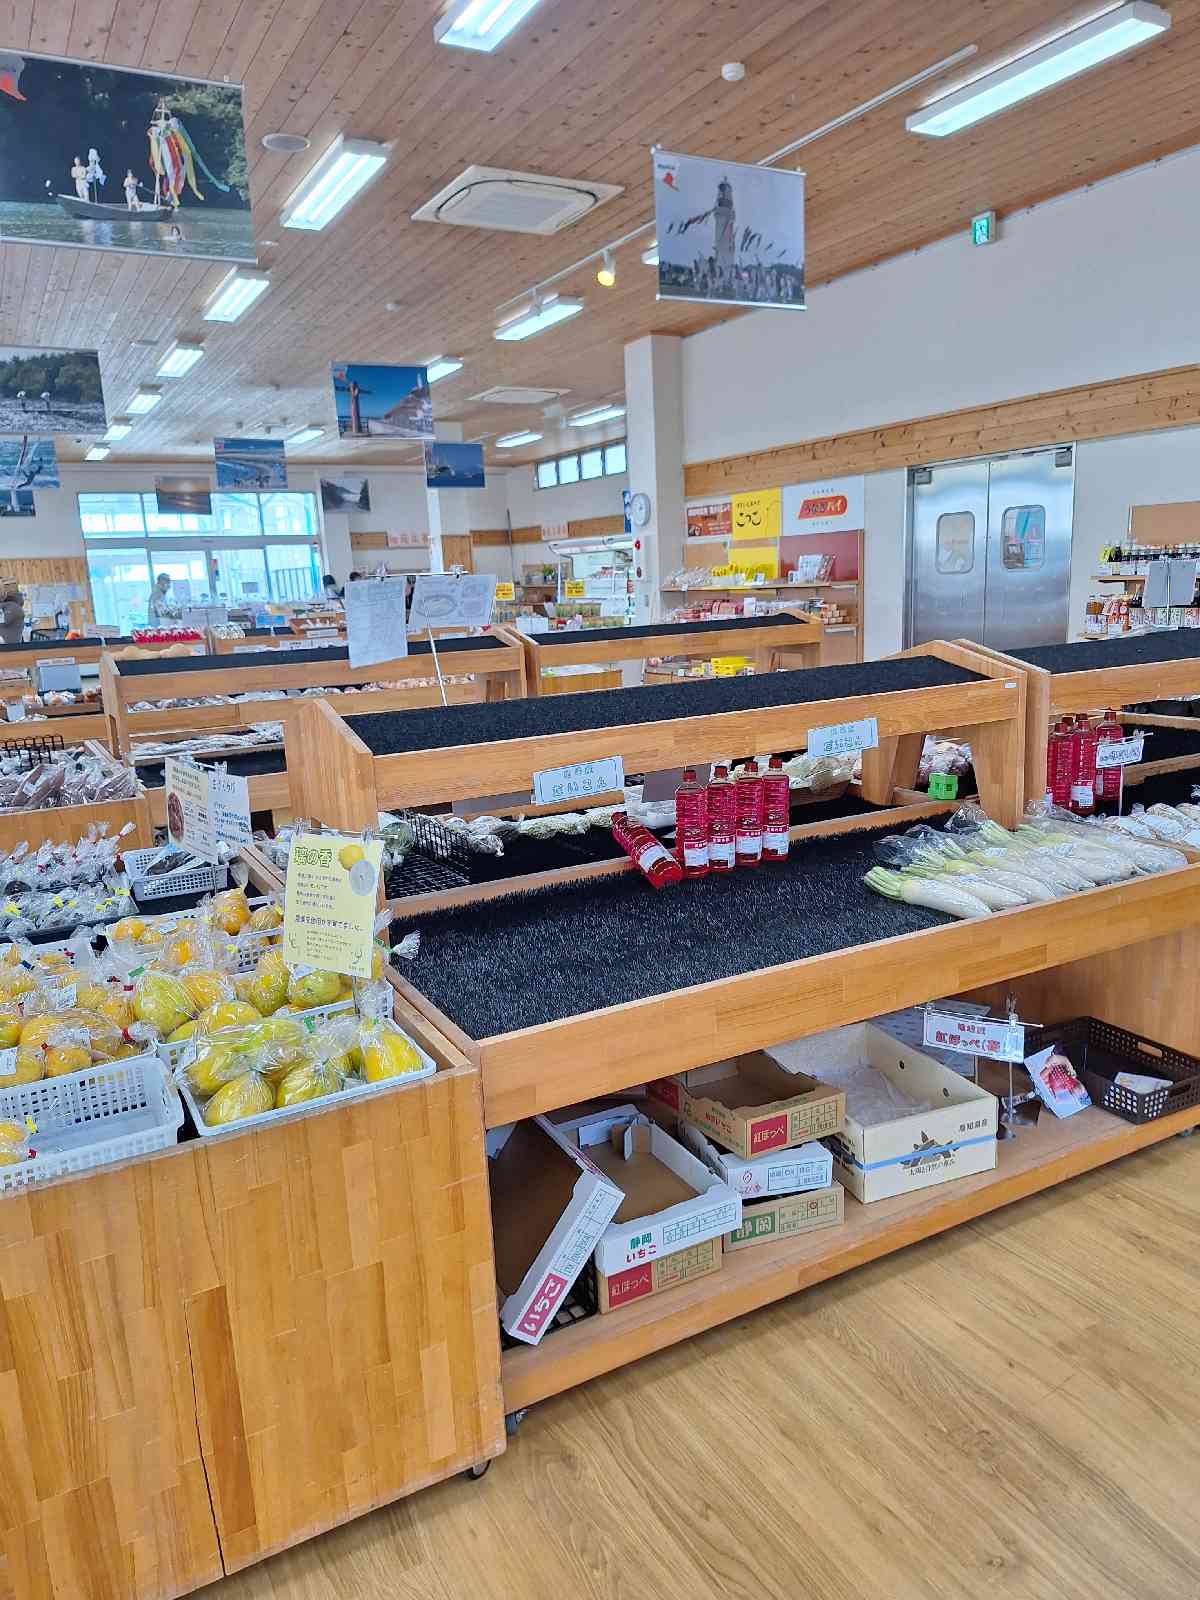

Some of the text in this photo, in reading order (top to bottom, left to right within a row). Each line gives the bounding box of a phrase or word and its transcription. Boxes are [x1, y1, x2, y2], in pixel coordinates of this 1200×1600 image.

[753, 1125, 785, 1144] 紅ほっぺ
[630, 1232, 652, 1250] 静岡
[611, 1272, 649, 1296] 紅ほっぺ
[524, 1280, 561, 1331] いちご
